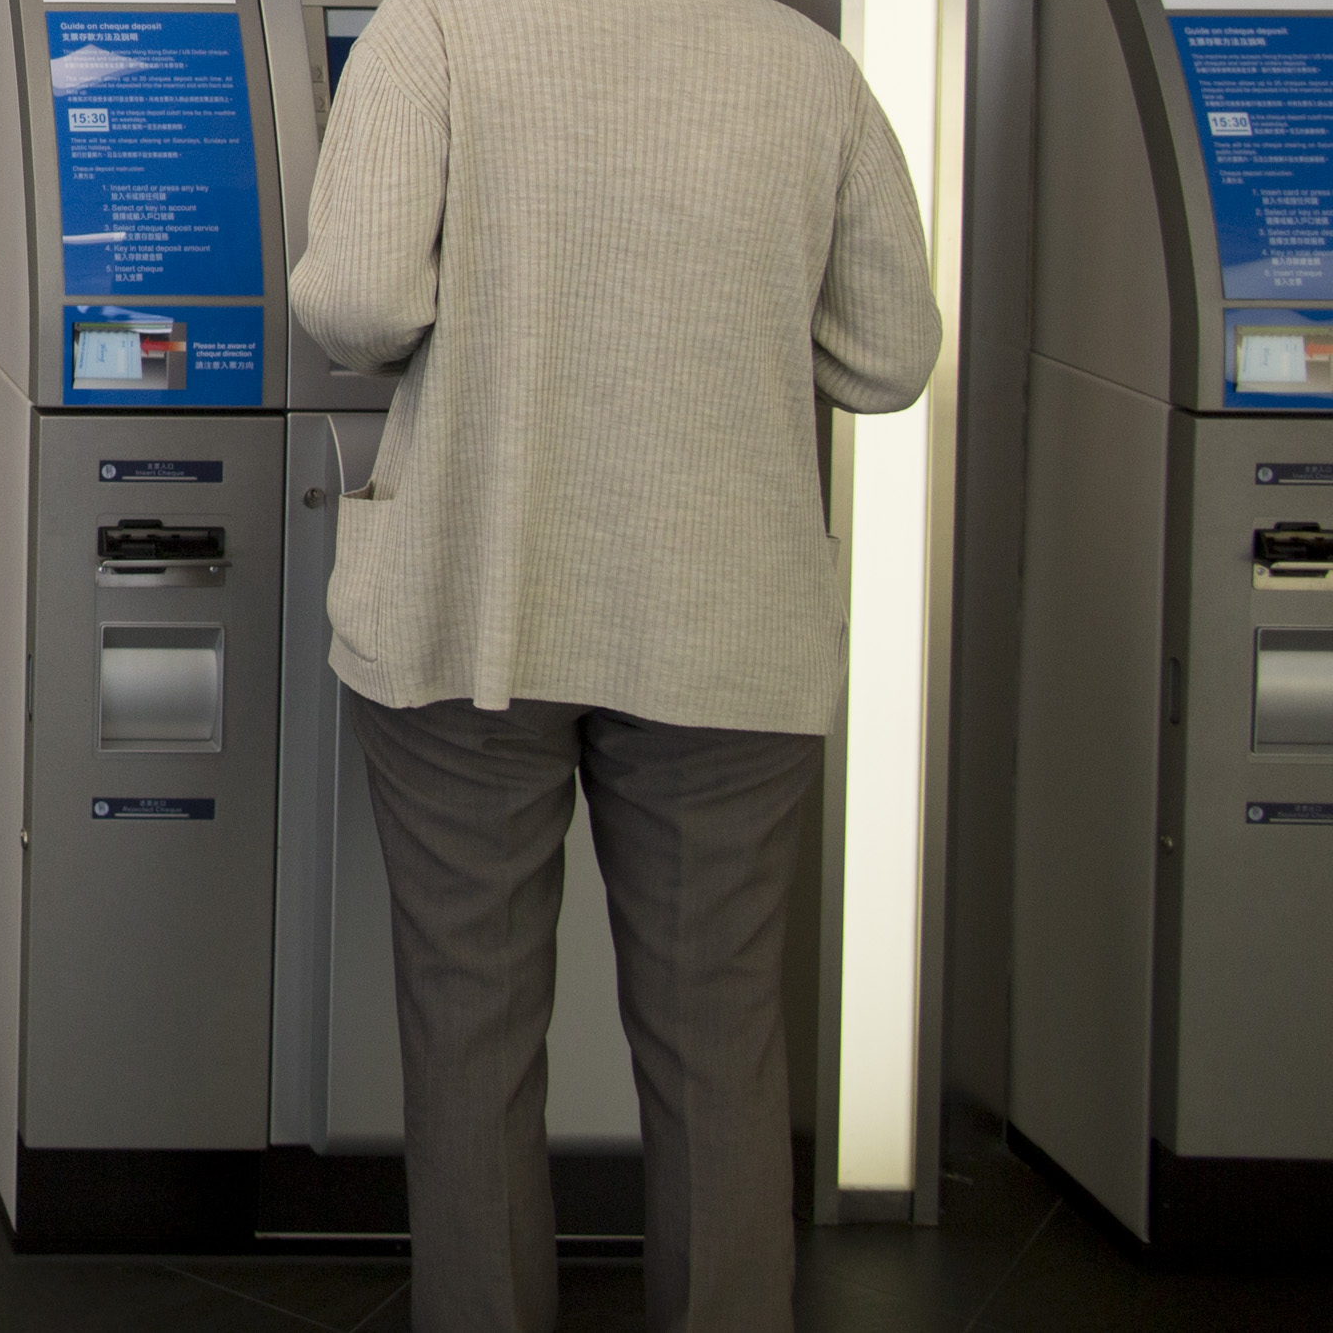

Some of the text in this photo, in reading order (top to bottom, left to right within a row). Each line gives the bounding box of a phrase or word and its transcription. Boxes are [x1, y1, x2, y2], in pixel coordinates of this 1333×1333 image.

[60, 22, 86, 30] Guide
[99, 22, 130, 32] cheque
[131, 22, 163, 32] deposit
[1184, 27, 1209, 35] Guide
[1223, 27, 1255, 37] cheque
[1255, 27, 1288, 37] deposit
[71, 112, 107, 124] 15:30
[1210, 116, 1248, 129] 15:30
[159, 185, 180, 193] press
[195, 184, 209, 193] key
[111, 204, 135, 212] Select
[165, 224, 192, 233] deposit
[113, 245, 128, 253] Key
[155, 245, 182, 254] deposit
[114, 265, 164, 274] Insert cheque
[192, 342, 216, 350] Please
[247, 342, 256, 350] of
[195, 350, 253, 359] cheque direction
